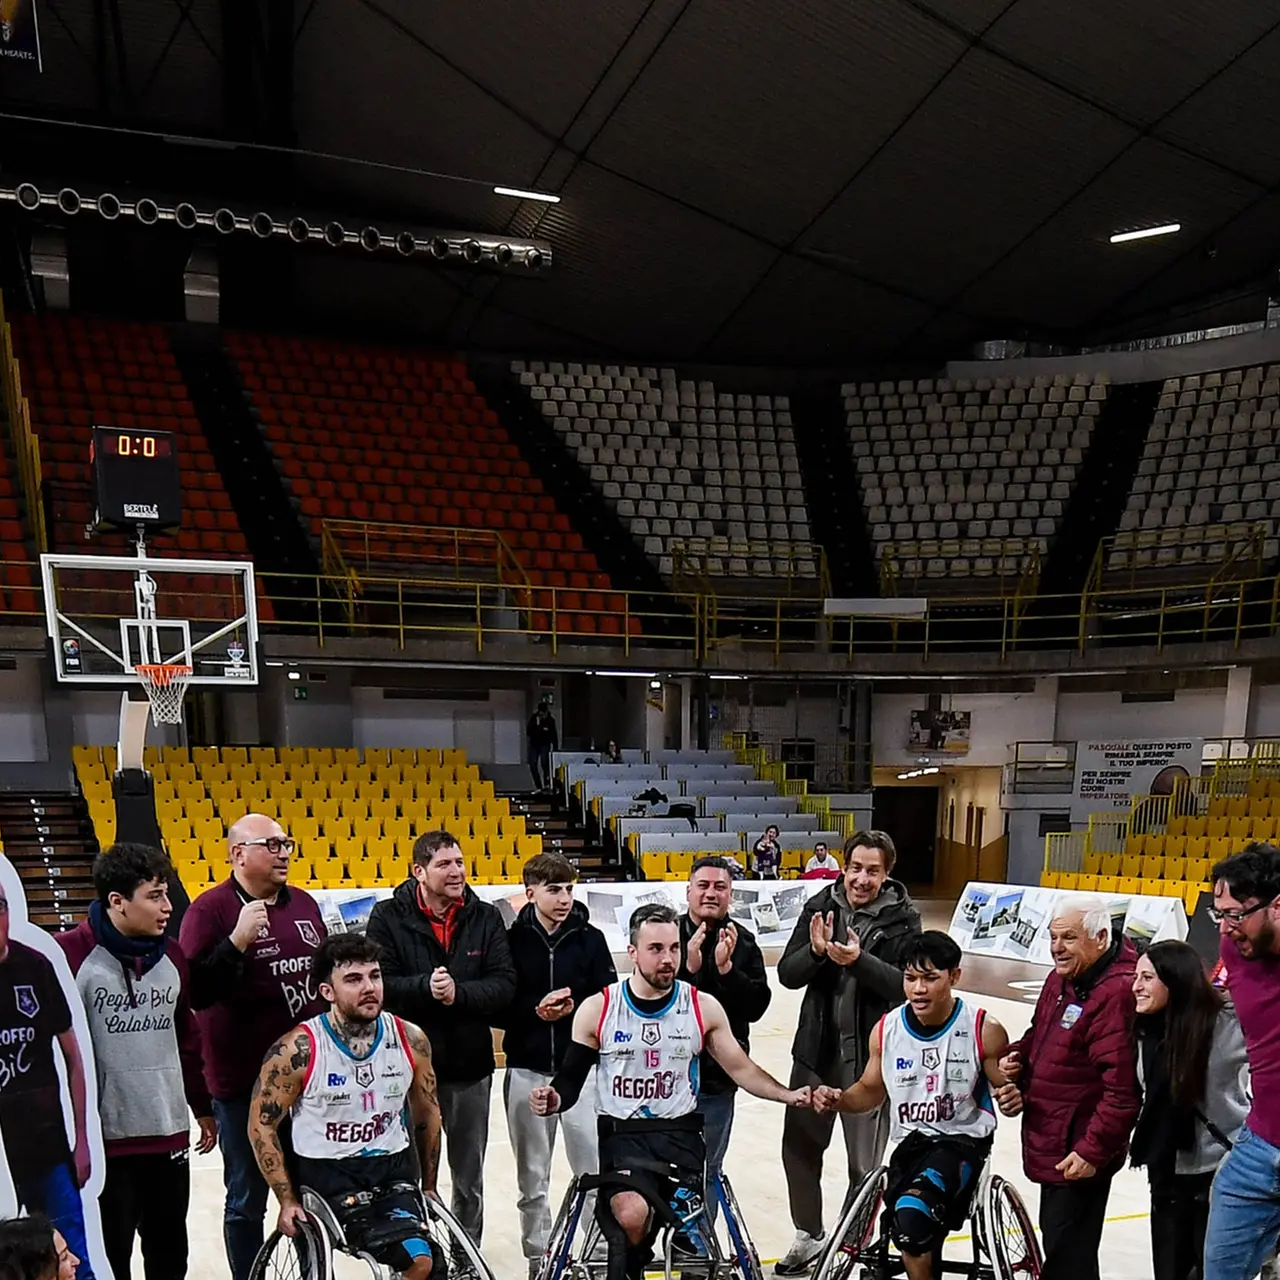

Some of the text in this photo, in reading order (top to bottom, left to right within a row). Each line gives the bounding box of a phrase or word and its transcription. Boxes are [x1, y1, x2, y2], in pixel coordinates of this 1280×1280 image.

[1088, 742, 1192, 752] PASQUALE QUESTO POSTO
[1142, 750, 1175, 759] SEMPRE
[1118, 759, 1135, 767] TUO
[1081, 770, 1132, 778] PER SEMPRE
[269, 955, 312, 976] TROFE
[105, 1014, 173, 1034] Calabria
[644, 1049, 660, 1070] 15
